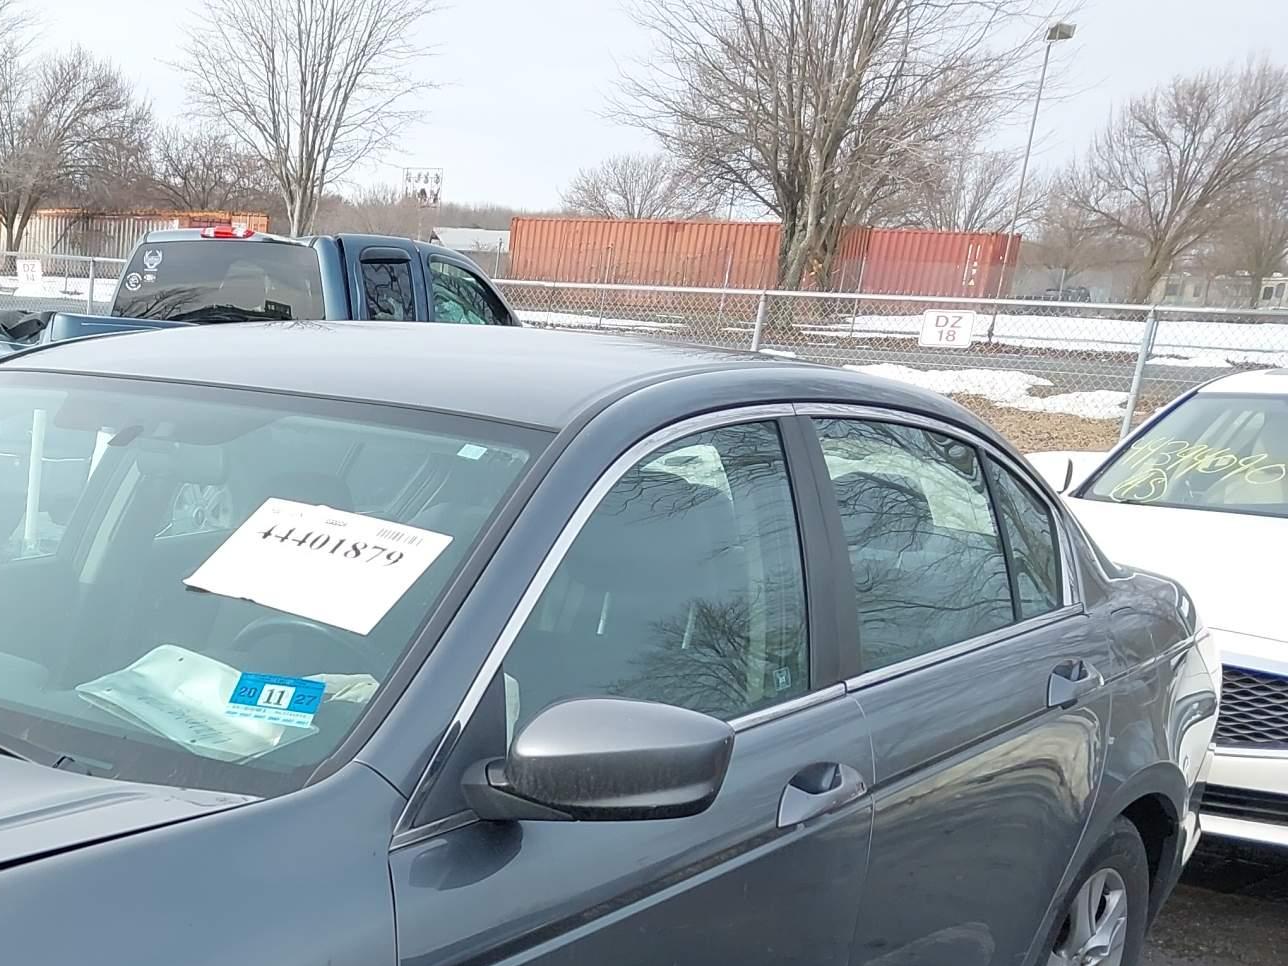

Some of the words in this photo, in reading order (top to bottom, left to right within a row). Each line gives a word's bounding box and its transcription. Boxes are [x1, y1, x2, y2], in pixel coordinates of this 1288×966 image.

[23, 263, 36, 273] DZ
[935, 314, 963, 328] DZ
[937, 329, 957, 342] 18
[256, 523, 404, 567] 44401879
[239, 687, 258, 698] 20
[262, 688, 286, 706] 11
[293, 694, 318, 706] 27
